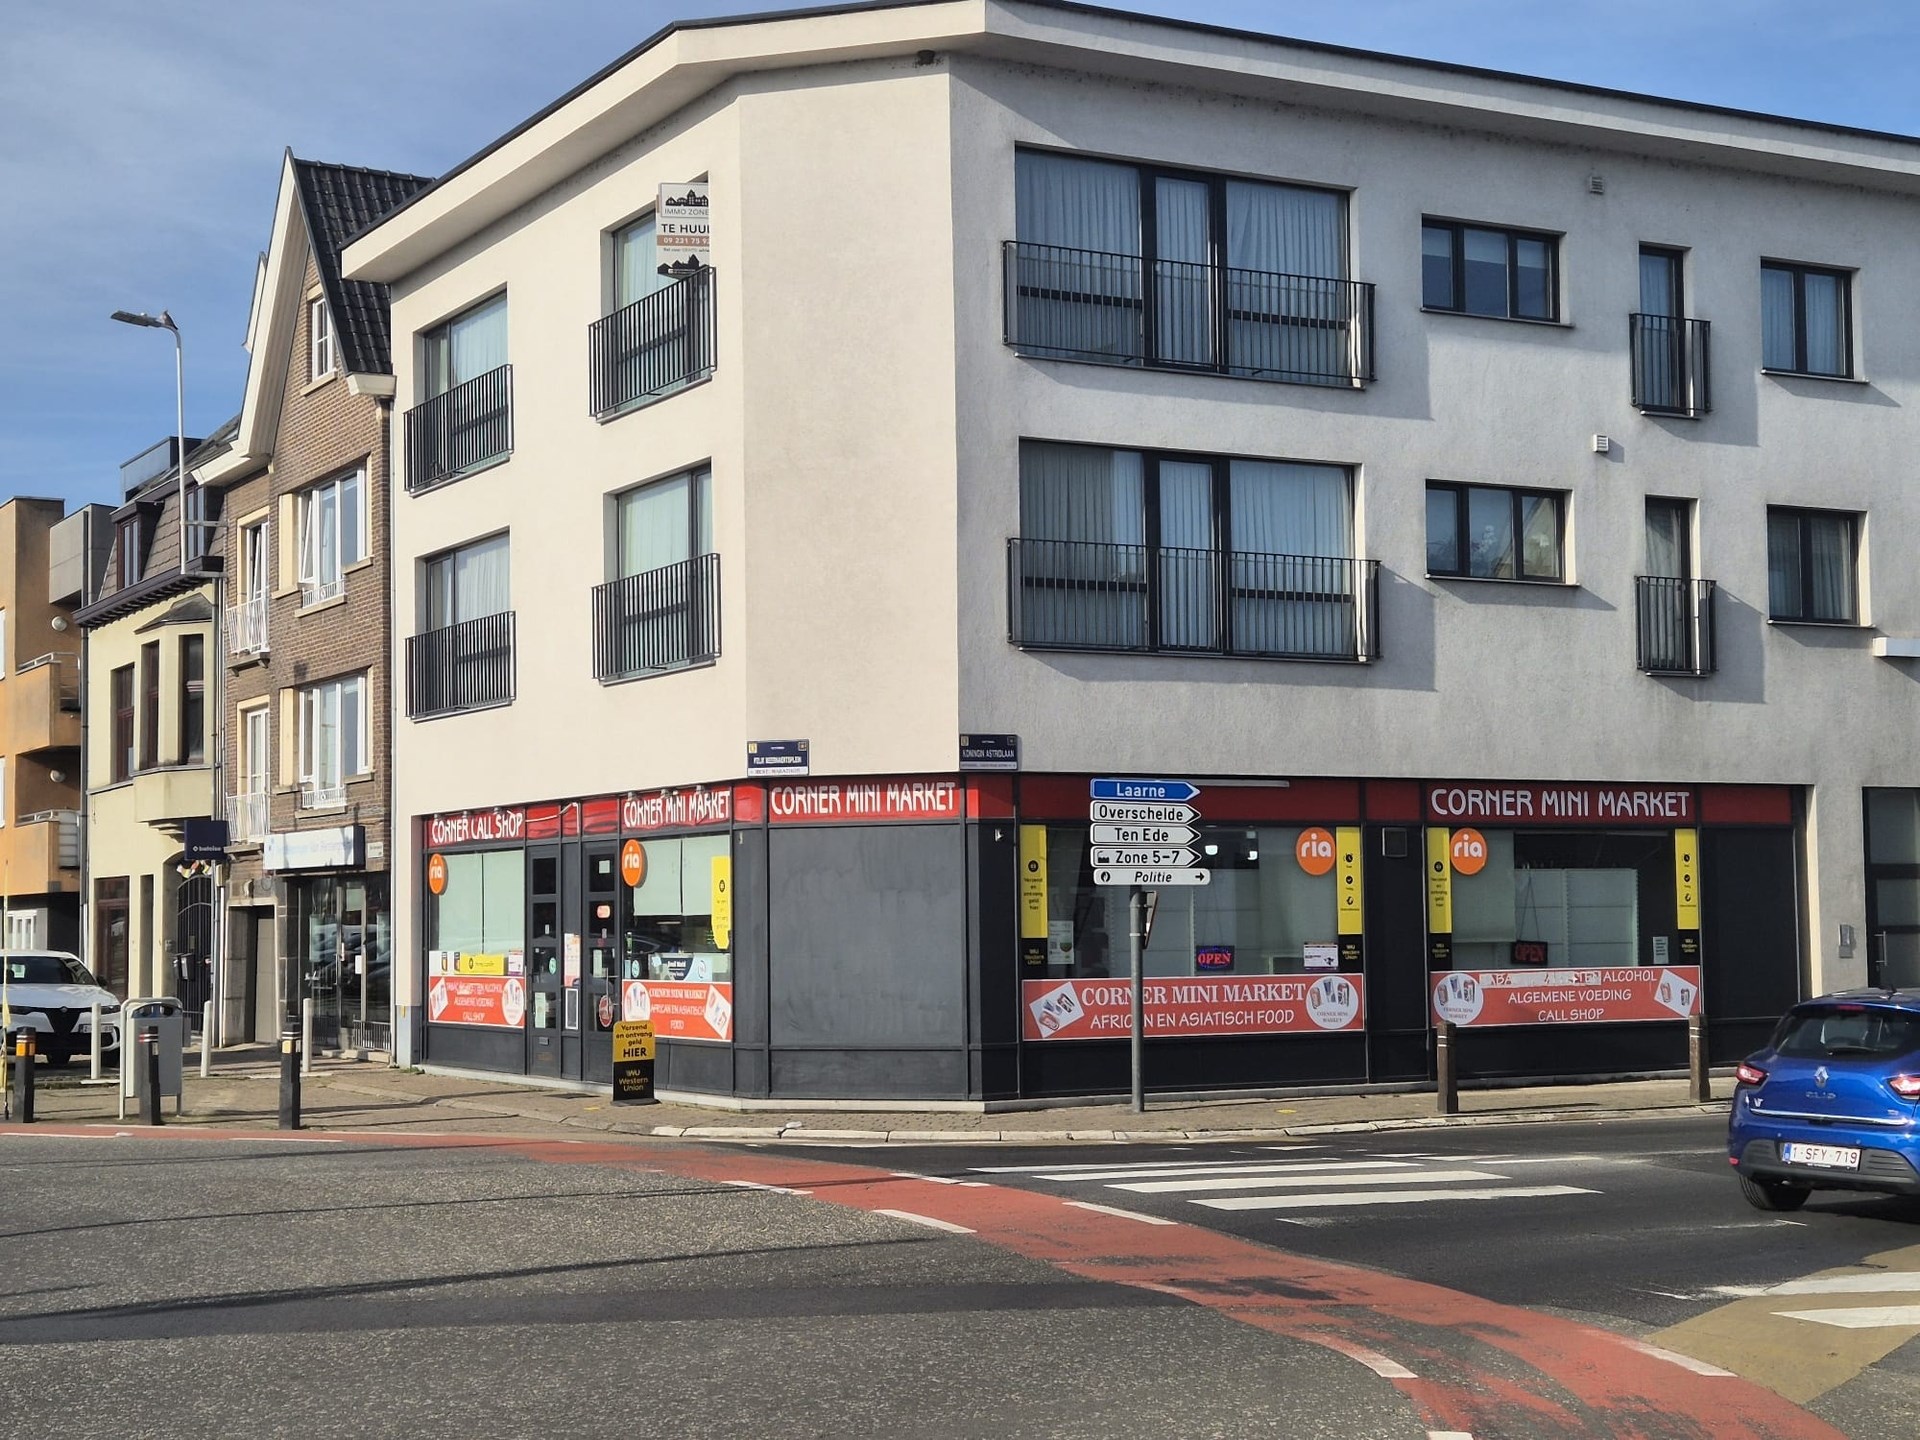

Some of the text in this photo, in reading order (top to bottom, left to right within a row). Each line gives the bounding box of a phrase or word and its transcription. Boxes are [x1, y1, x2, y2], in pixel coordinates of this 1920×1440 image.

[661, 223, 676, 233] TE
[1116, 782, 1166, 798] Laarne
[771, 782, 956, 815] CORNER MINI MARKET
[1431, 788, 1690, 817] CORNER MINI MARKET
[623, 790, 731, 828] CORNER MINI MARKET
[1099, 804, 1184, 821] Overschelde
[431, 812, 523, 843] CORNER CALL SHOP
[1114, 827, 1169, 842] Ten Ede
[1301, 833, 1332, 858] ria
[1454, 833, 1483, 858] ria
[624, 845, 640, 869] ria
[1115, 850, 1180, 864] Zone 5-7
[430, 858, 443, 879] ria
[1134, 871, 1172, 883] Politie
[1197, 952, 1232, 965] OPEN
[1603, 969, 1657, 982] ALCOHOL
[1172, 985, 1218, 1005] MINI
[1222, 983, 1306, 1003] MARKET
[1507, 989, 1632, 1004] ALGEMENE VOEDING
[1090, 1009, 1295, 1029] AFRICN EN ASIATISCH FOOD
[1538, 1008, 1605, 1022] CALL SHOP
[621, 1023, 648, 1031] Verzend
[625, 1031, 653, 1039] ontvang
[628, 1038, 642, 1046] geld
[623, 1047, 647, 1058] HIER
[618, 1077, 649, 1085] Western
